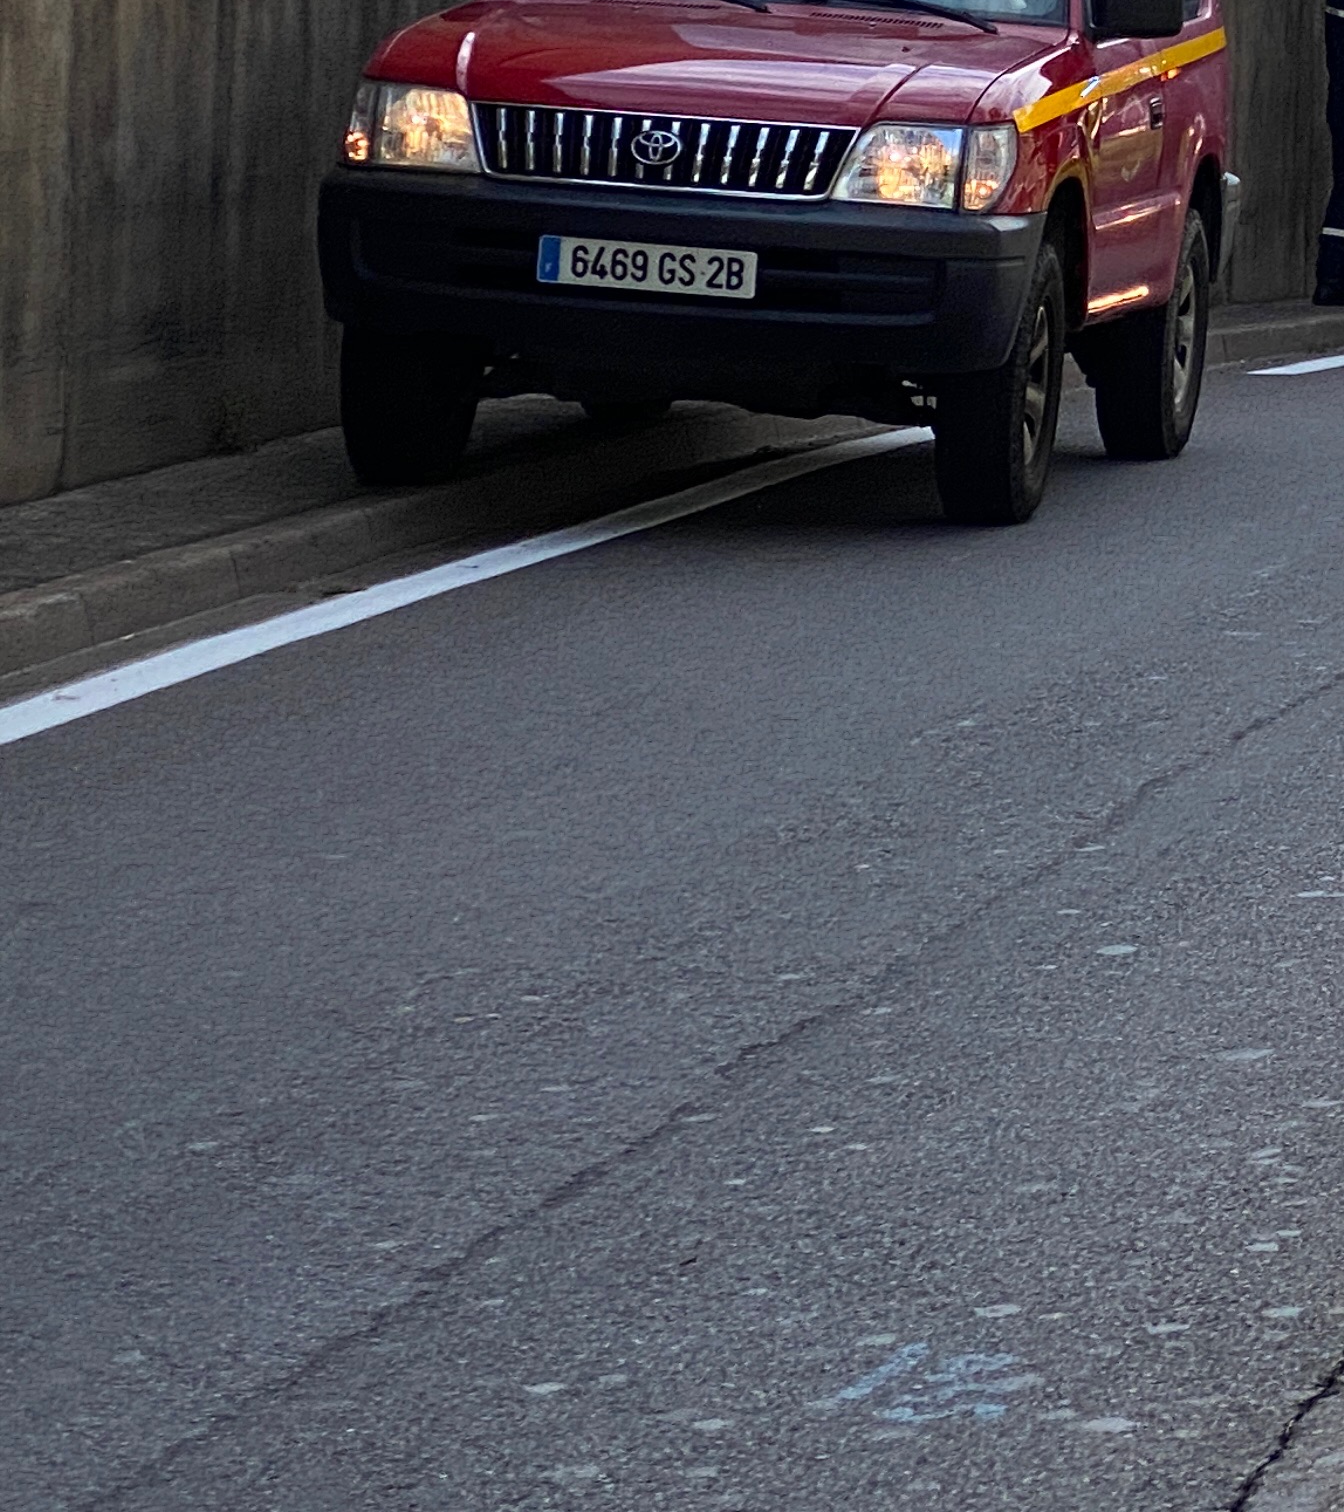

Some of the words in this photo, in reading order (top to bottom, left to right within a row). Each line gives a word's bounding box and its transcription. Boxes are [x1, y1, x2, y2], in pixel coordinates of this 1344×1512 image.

[571, 245, 649, 283] 6469
[658, 252, 696, 287] GS
[706, 256, 744, 290] 2B
